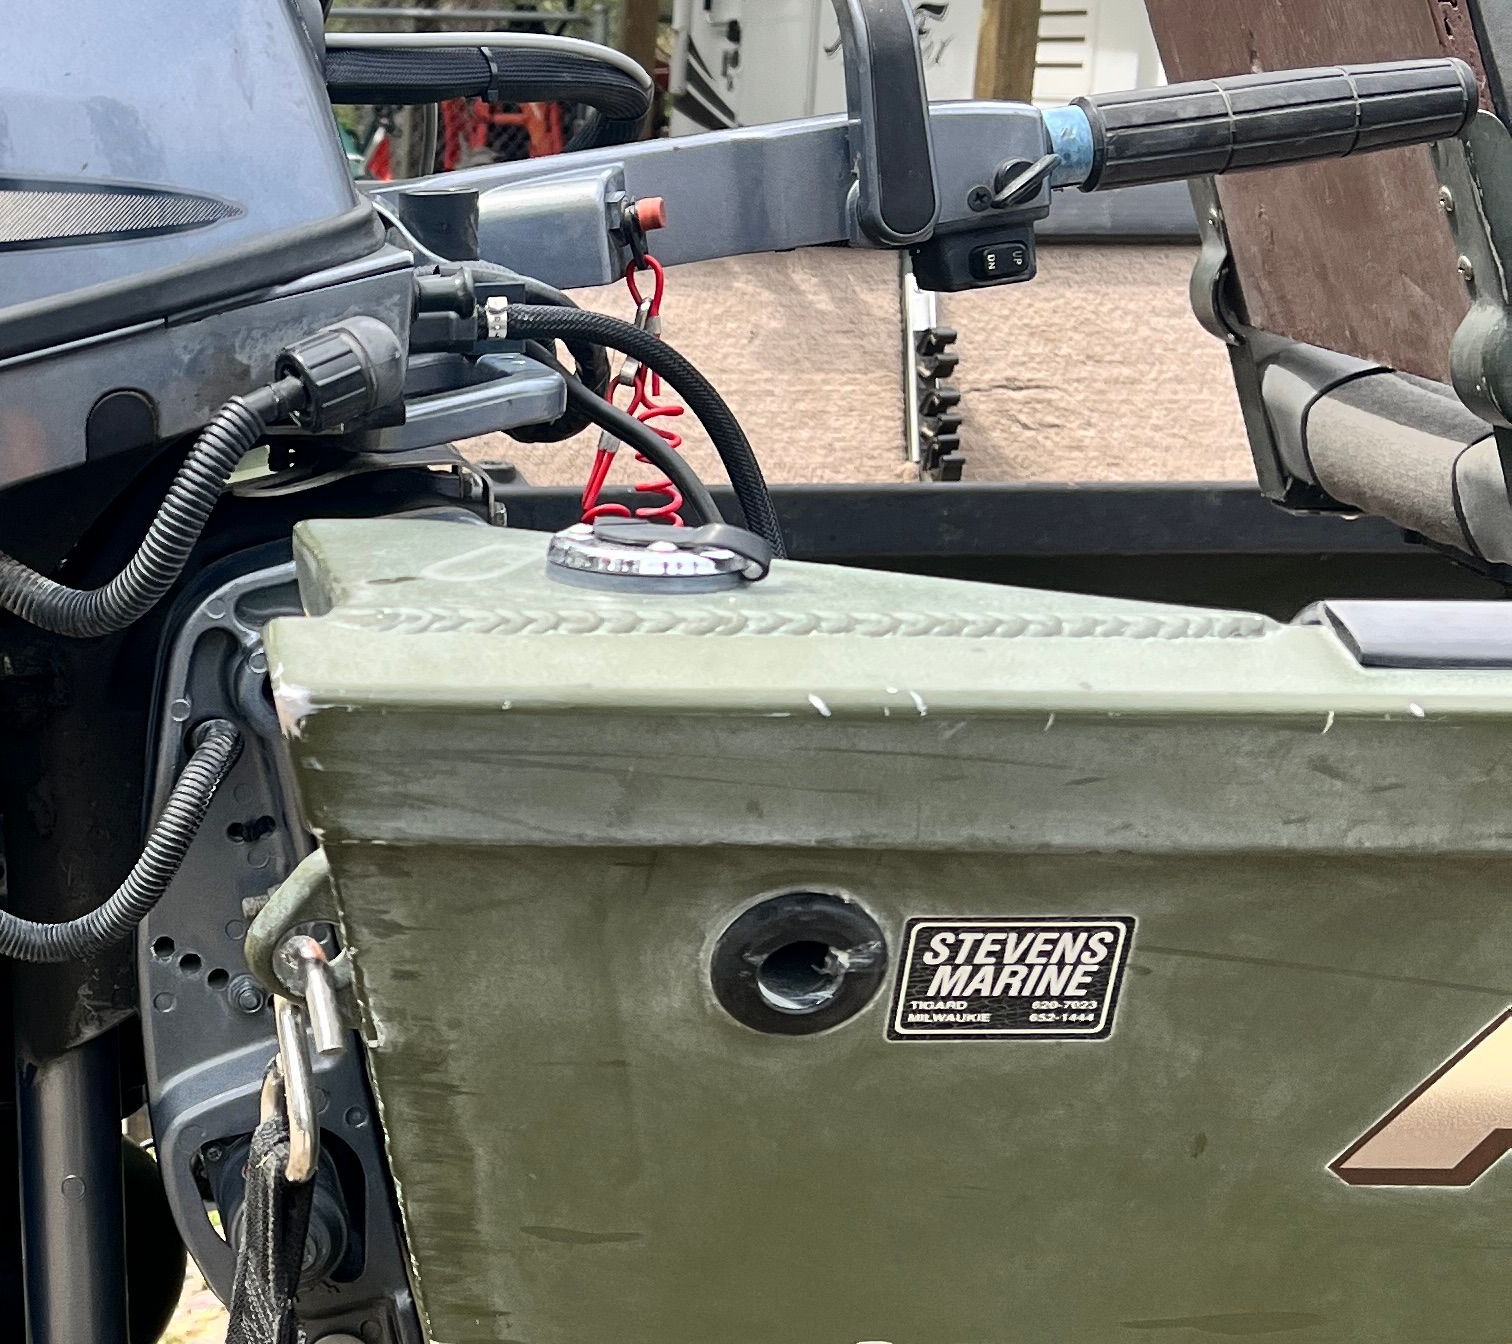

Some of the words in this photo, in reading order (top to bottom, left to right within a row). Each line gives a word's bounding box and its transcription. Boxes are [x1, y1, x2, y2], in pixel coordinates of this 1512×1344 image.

[987, 254, 996, 270] DN
[1012, 250, 1023, 265] UP
[923, 931, 1114, 966] STEVENS
[926, 964, 1100, 997] MARINE
[910, 1001, 968, 1010] TIGARD
